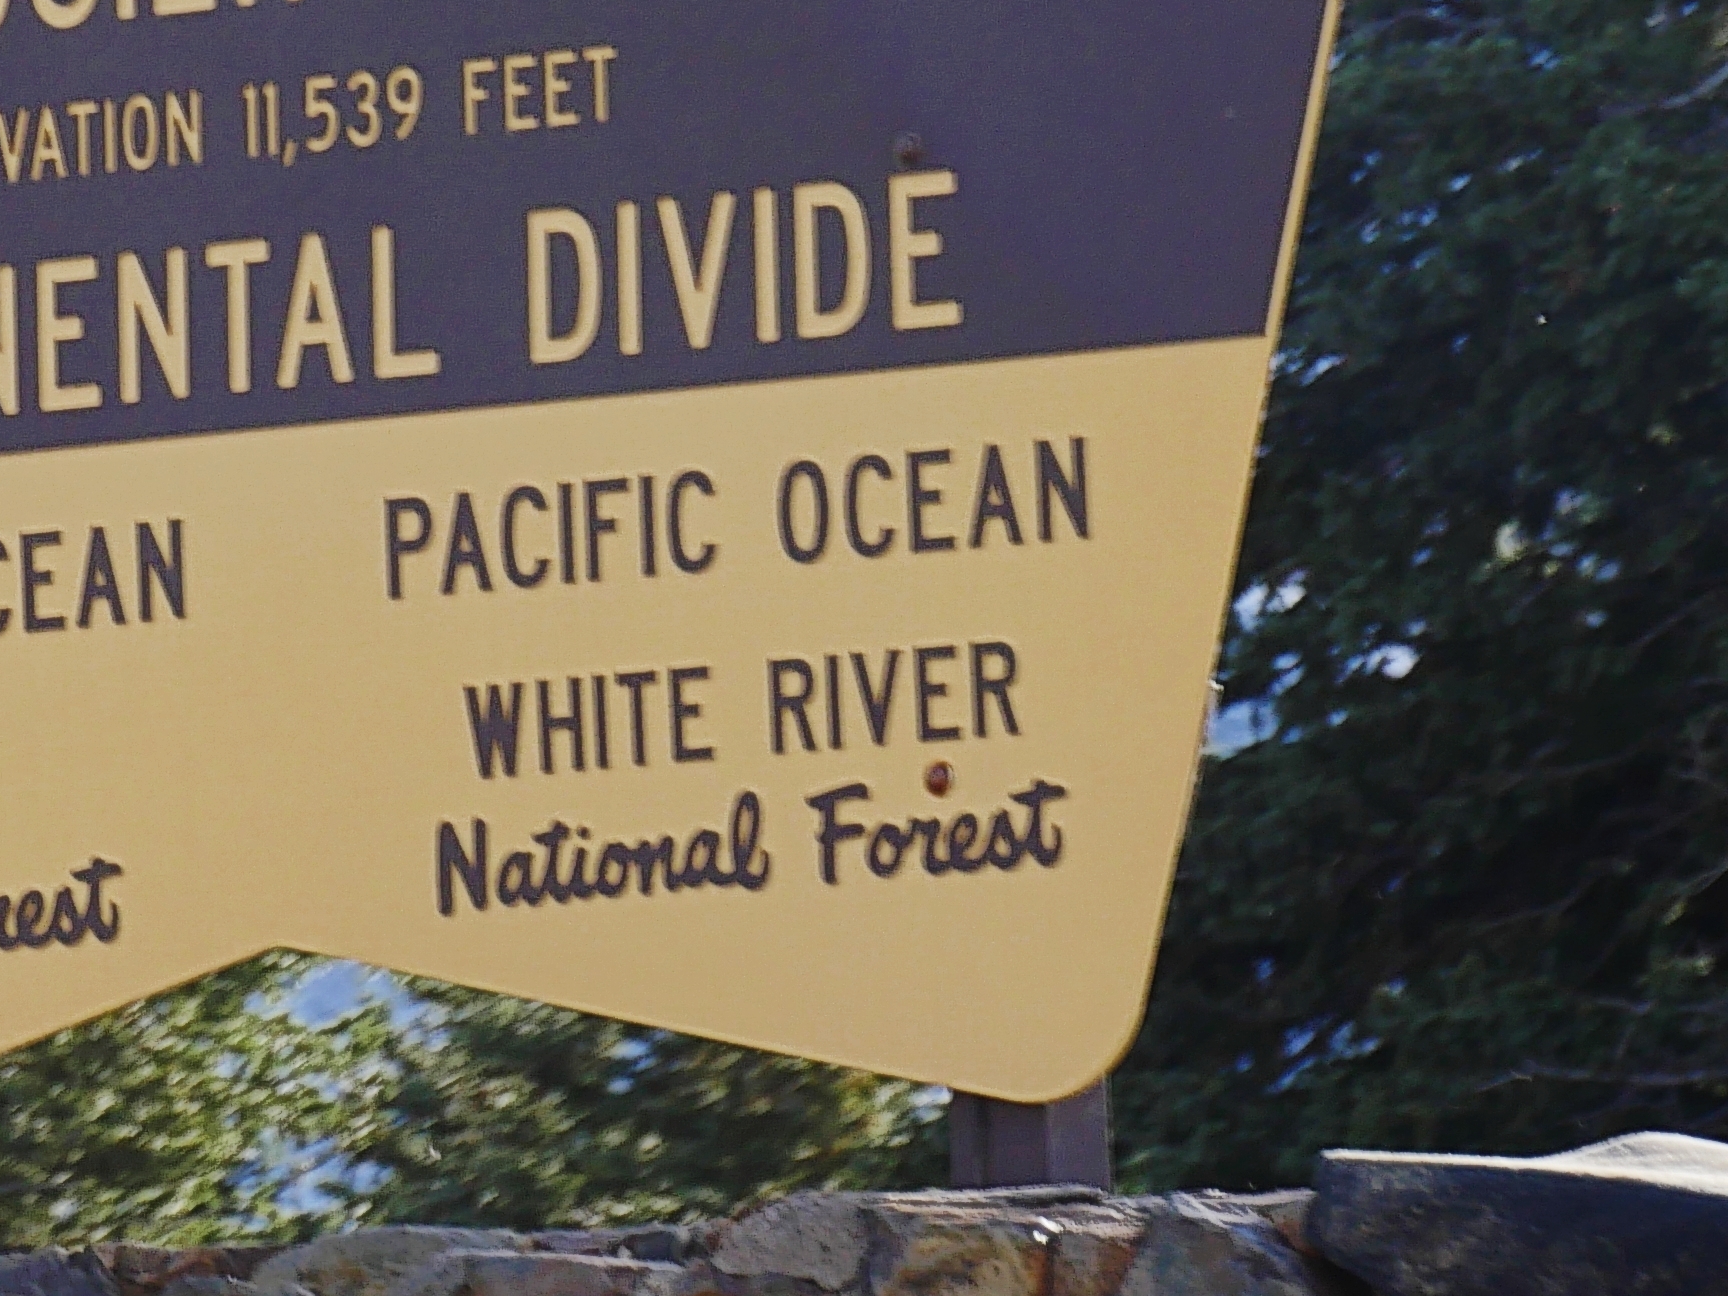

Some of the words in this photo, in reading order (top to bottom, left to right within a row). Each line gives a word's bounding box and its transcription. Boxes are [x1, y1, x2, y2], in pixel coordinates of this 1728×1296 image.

[241, 65, 424, 168] 11,539
[462, 44, 618, 137] FEET
[523, 169, 969, 370] DIVIDE
[386, 471, 713, 598] PACIFIC
[779, 440, 1089, 565] OCEAN
[466, 667, 713, 778] WHITE
[770, 642, 1017, 753] RIVER
[437, 784, 768, 918] National
[808, 782, 1064, 885] Forest
